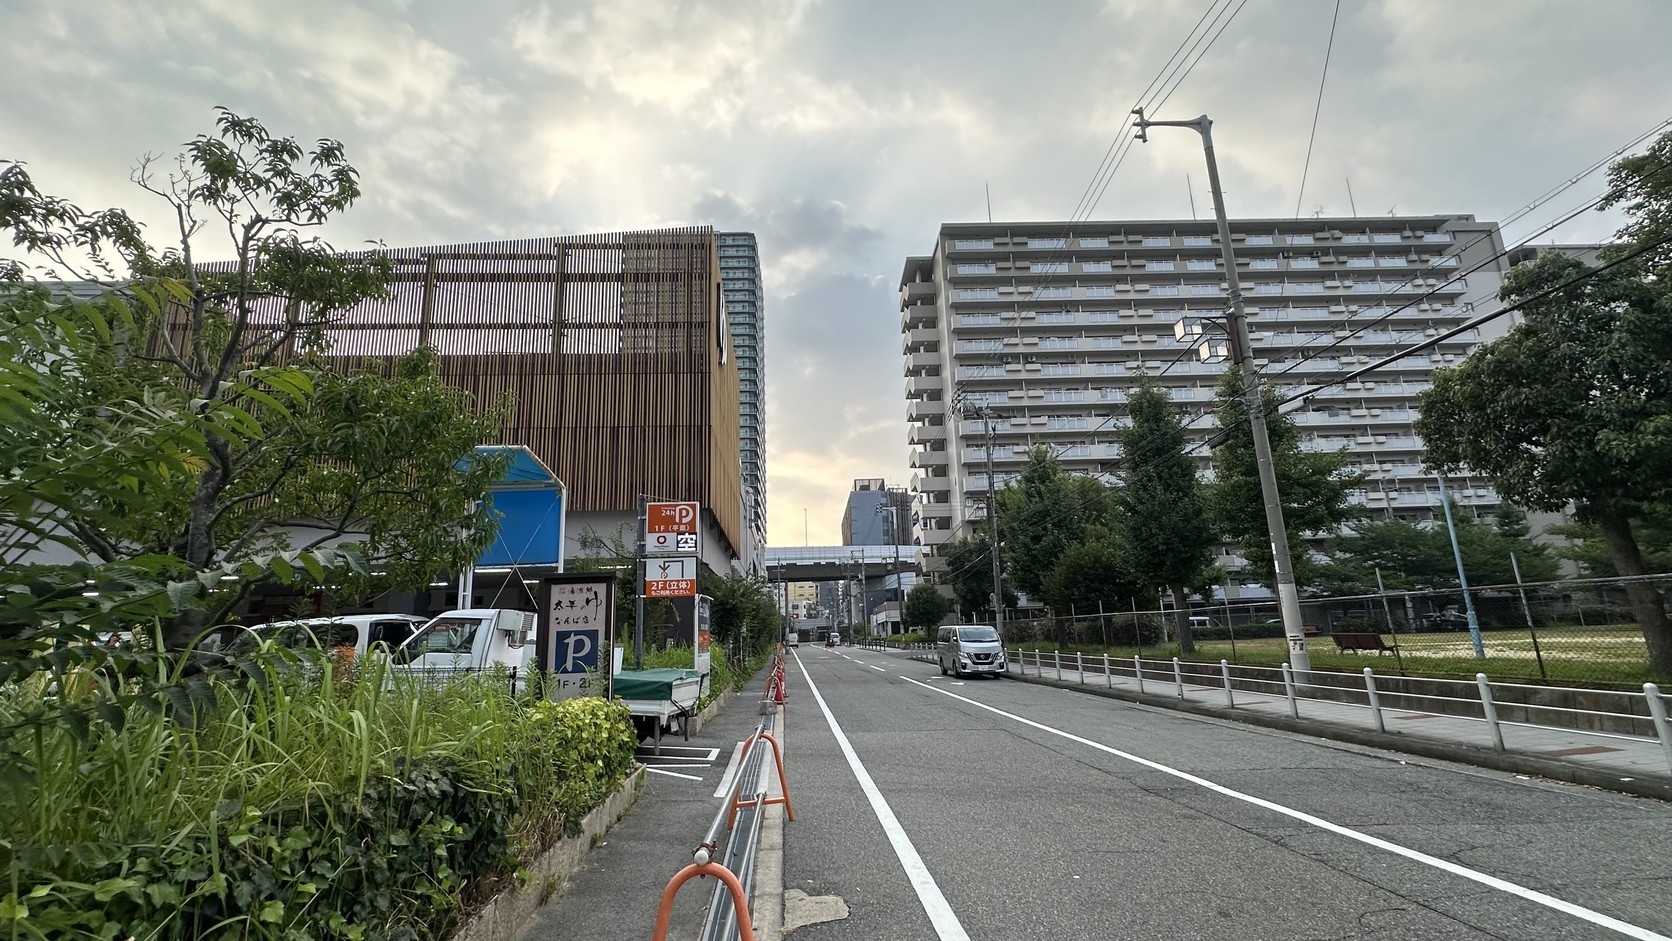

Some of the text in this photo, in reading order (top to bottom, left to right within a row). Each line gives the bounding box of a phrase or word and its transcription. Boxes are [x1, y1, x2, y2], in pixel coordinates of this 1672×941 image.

[675, 505, 693, 524] P
[677, 533, 696, 551] 空
[555, 616, 589, 625] なんば店
[563, 631, 592, 672] P
